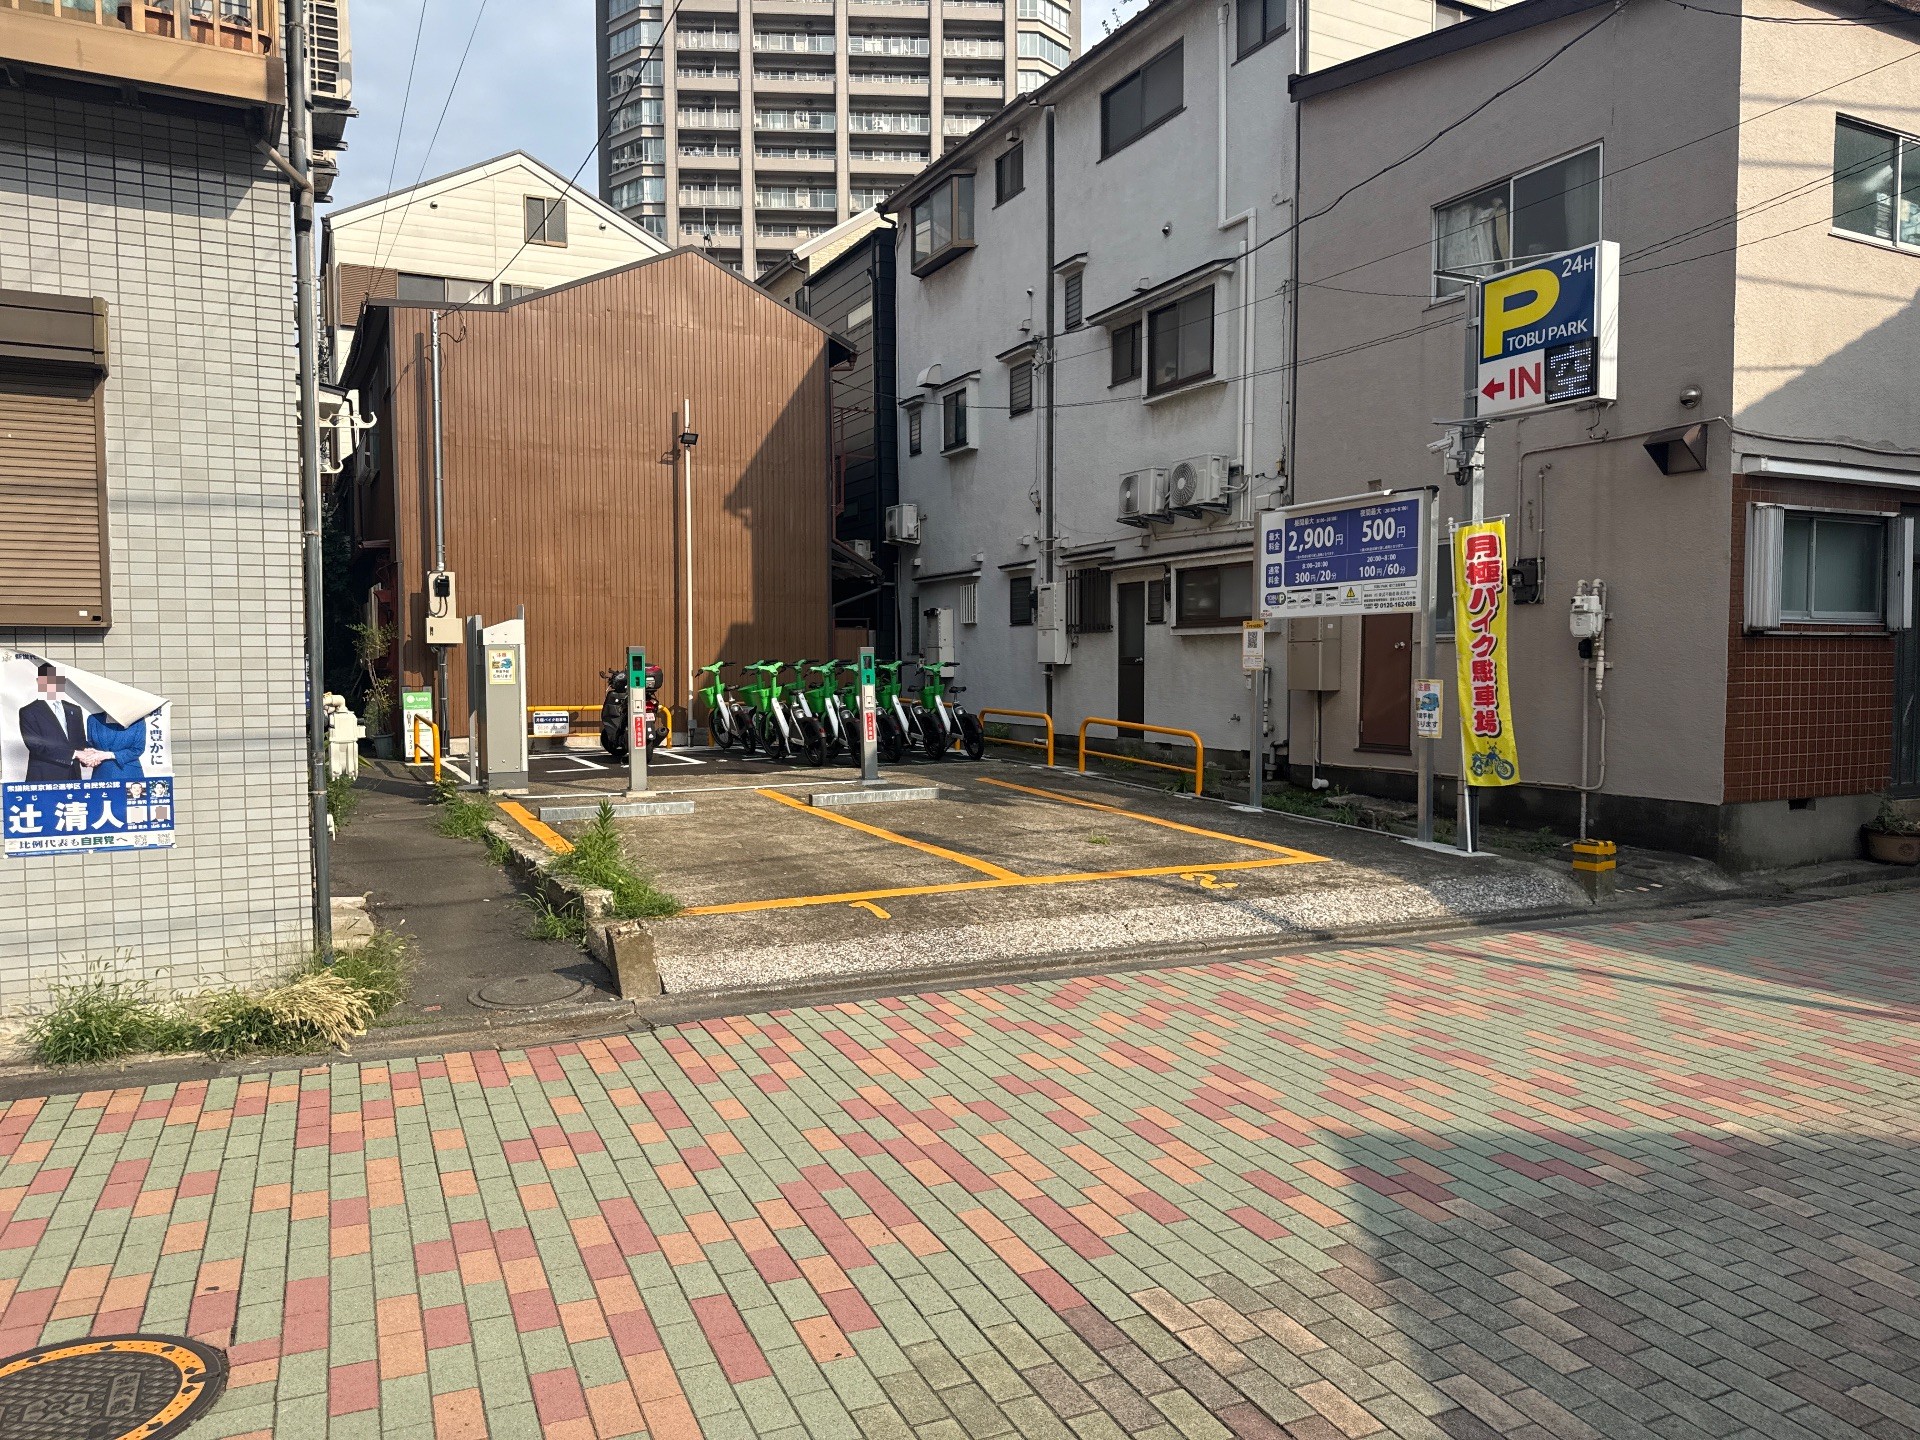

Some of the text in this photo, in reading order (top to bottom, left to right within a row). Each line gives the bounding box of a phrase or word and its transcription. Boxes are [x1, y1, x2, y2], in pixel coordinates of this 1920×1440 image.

[1562, 255, 1593, 278] 24H
[1484, 268, 1560, 358] P
[1507, 318, 1588, 352] TOBU PARK
[1510, 362, 1541, 400] IN
[1550, 345, 1591, 400] 空
[1268, 532, 1281, 541] 最大
[1288, 525, 1344, 552] 2,900円
[1361, 516, 1406, 543] 500円
[1268, 542, 1281, 551] 料金
[1268, 566, 1280, 575] 通常
[1268, 576, 1280, 585] 料金
[1466, 534, 1501, 733] 月極バイク駐車場
[9, 804, 43, 834] 辻
[19, 835, 128, 849] 比例代表も自民党へ
[1180, 872, 1239, 889] 2
